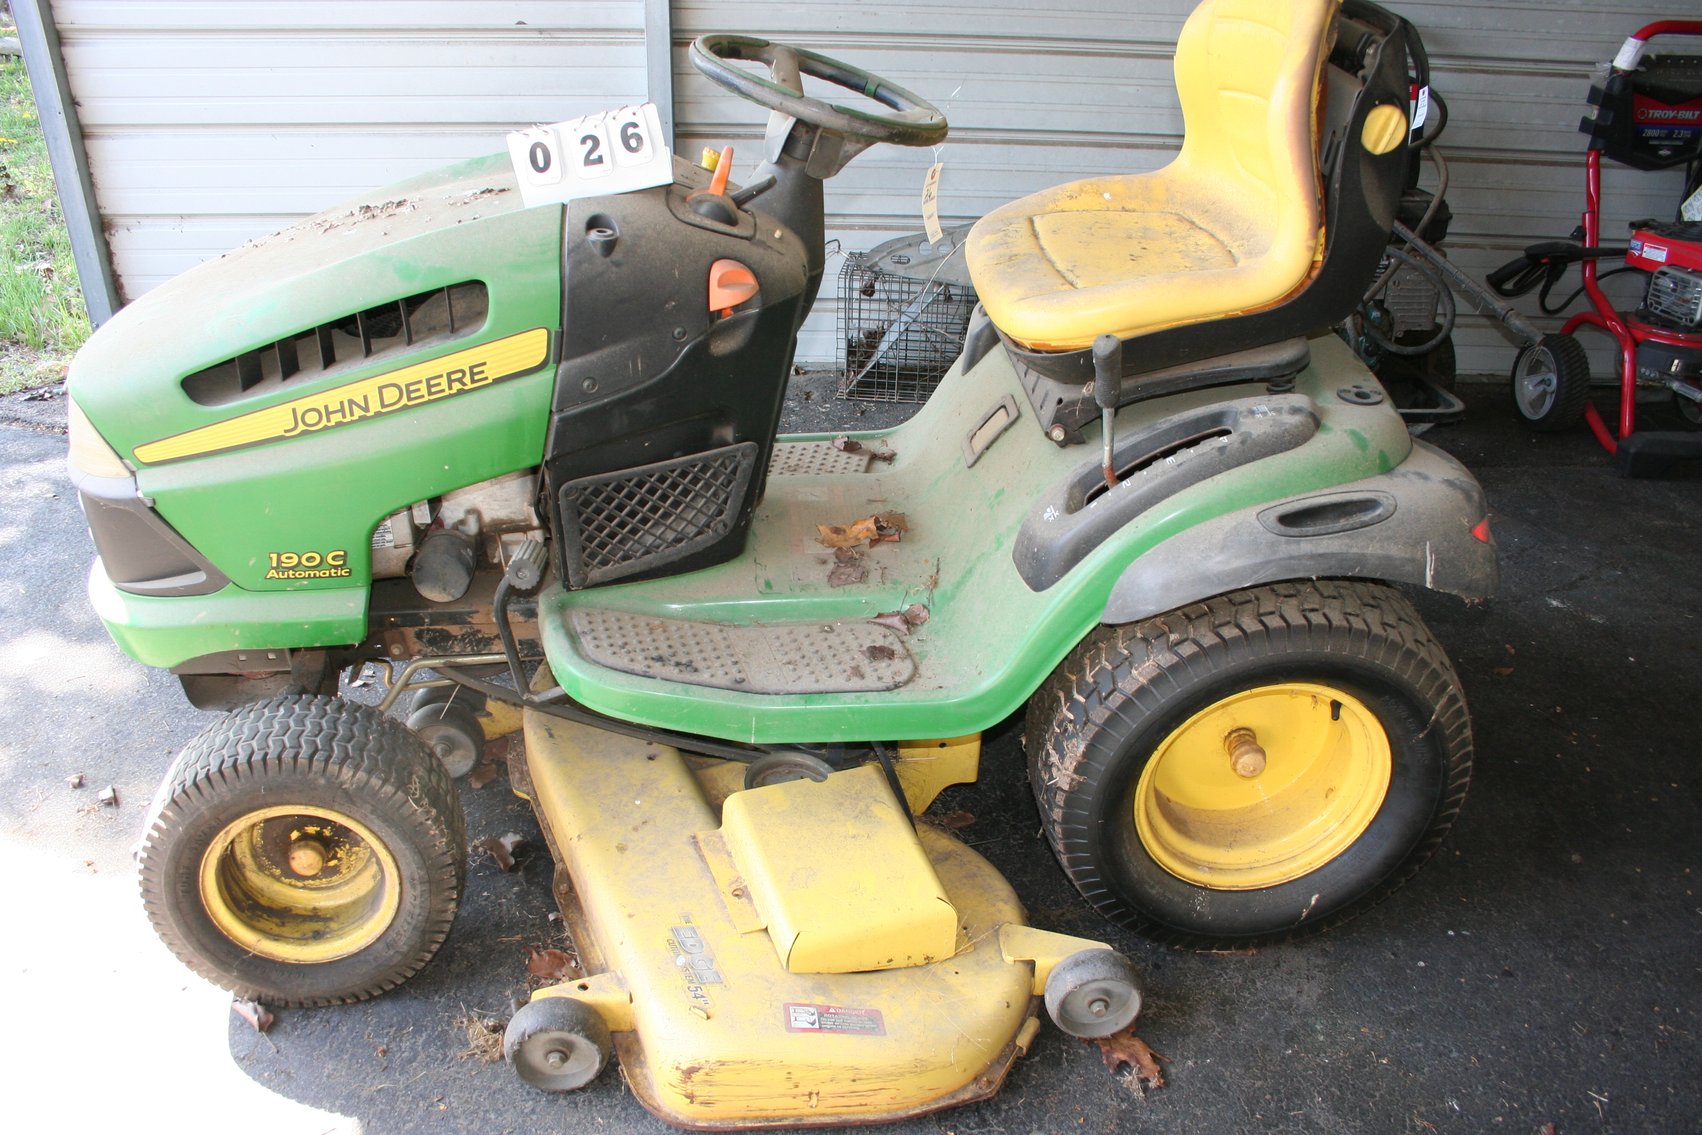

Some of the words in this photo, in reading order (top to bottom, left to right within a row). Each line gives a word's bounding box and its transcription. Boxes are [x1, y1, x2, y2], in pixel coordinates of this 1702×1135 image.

[1648, 109, 1700, 120] TROY-BILT
[284, 393, 370, 434] JOHN
[377, 361, 489, 410] DEERE
[265, 567, 351, 579] Automatic
